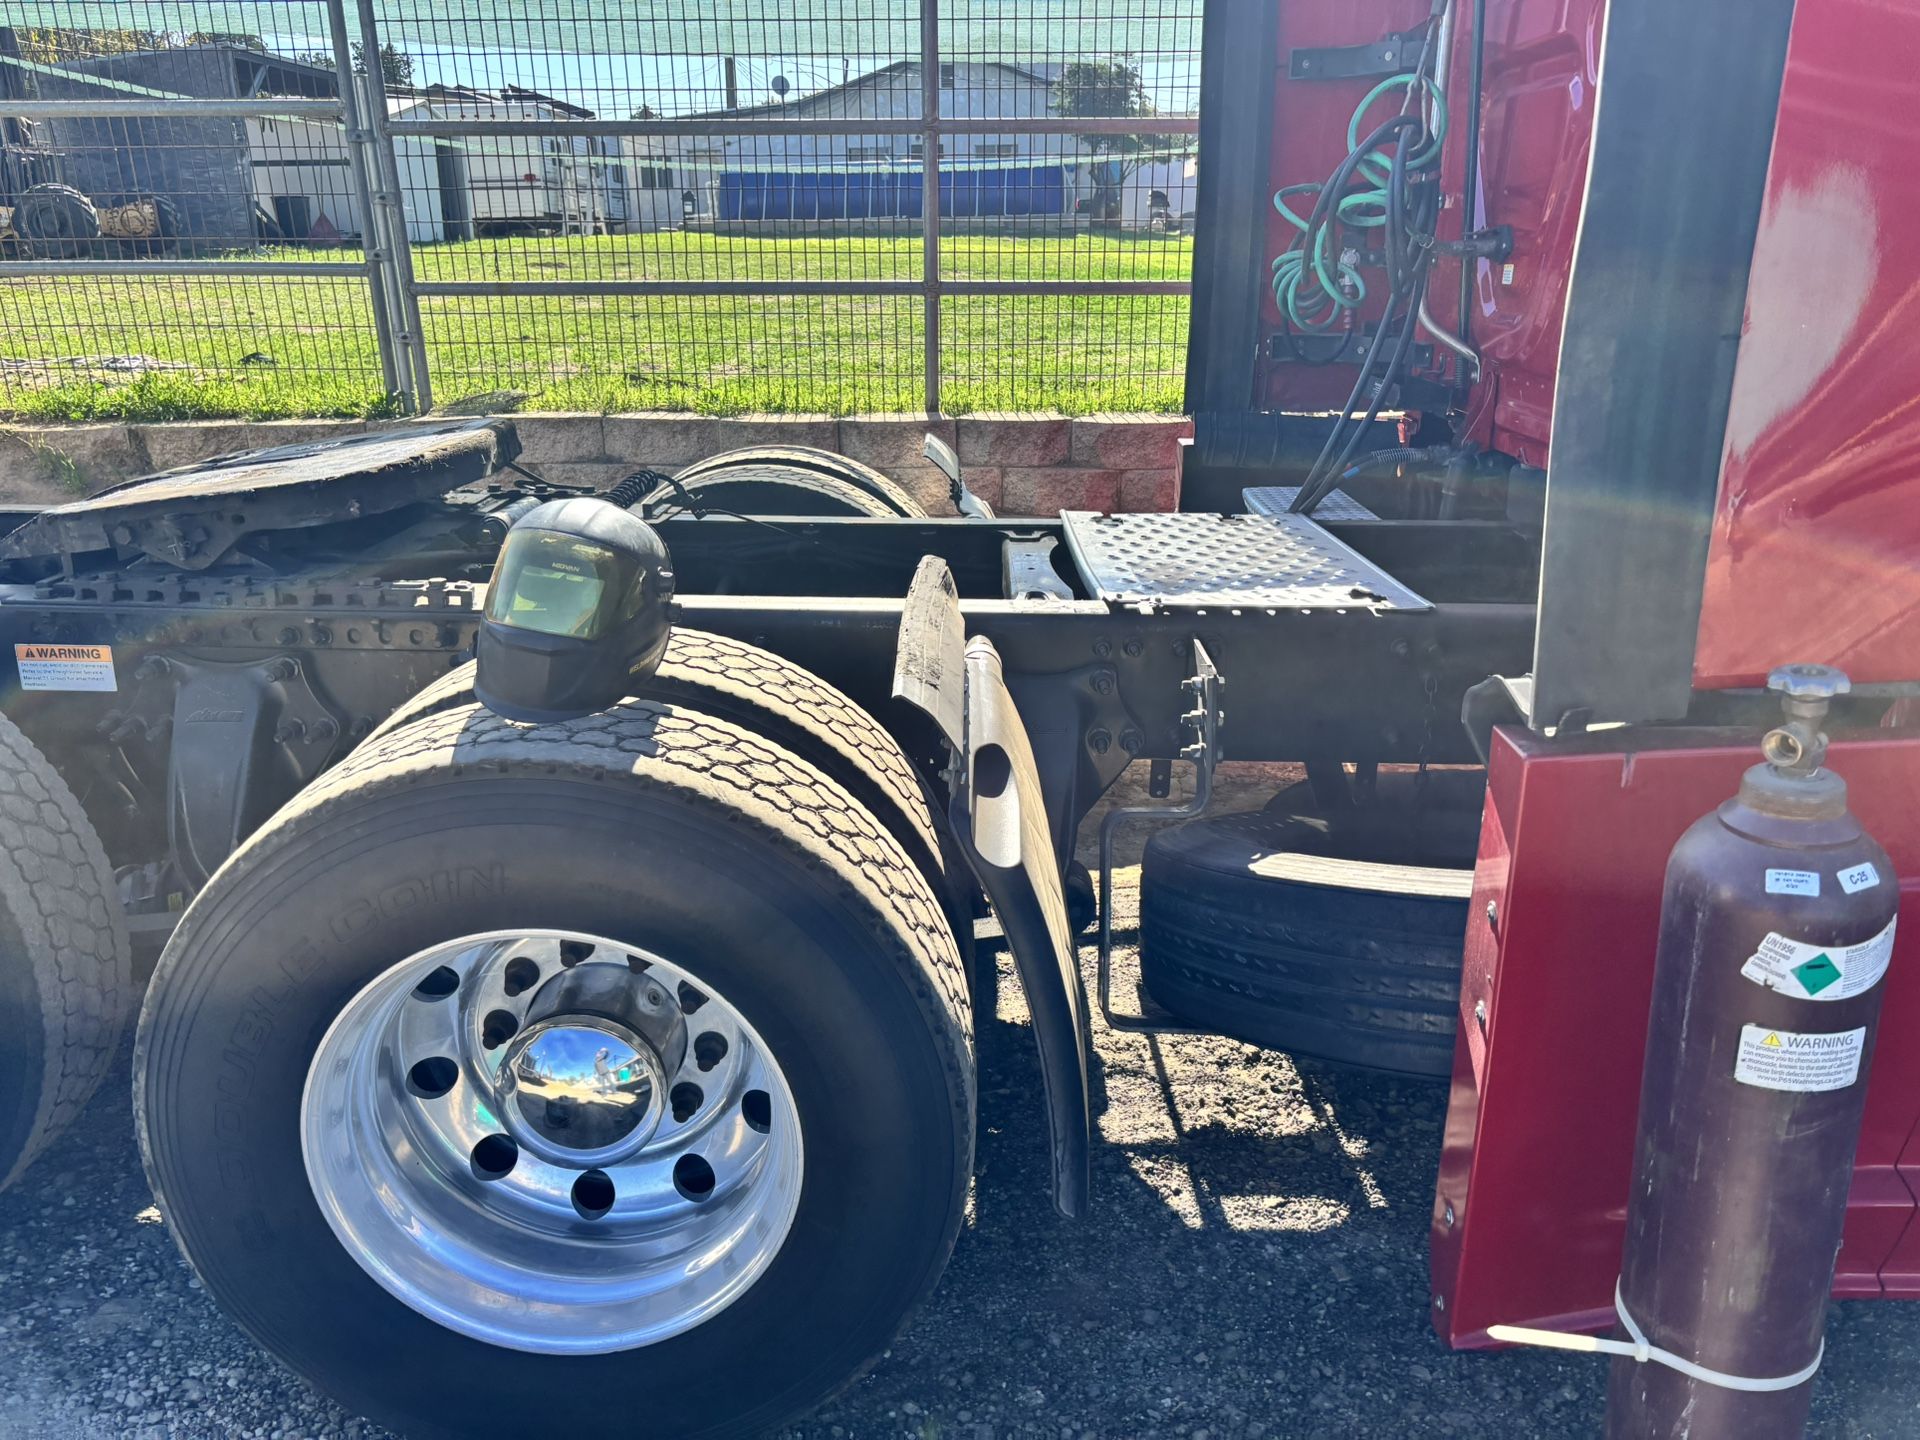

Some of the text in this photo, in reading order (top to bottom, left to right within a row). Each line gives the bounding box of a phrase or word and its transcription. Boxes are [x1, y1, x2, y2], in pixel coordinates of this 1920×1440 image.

[36, 648, 101, 659] WARNING
[1849, 871, 1868, 885] C-25
[1765, 935, 1797, 955] UN1956
[214, 863, 506, 1192] DOUBLE COIN
[1787, 1034, 1854, 1048] WARNING
